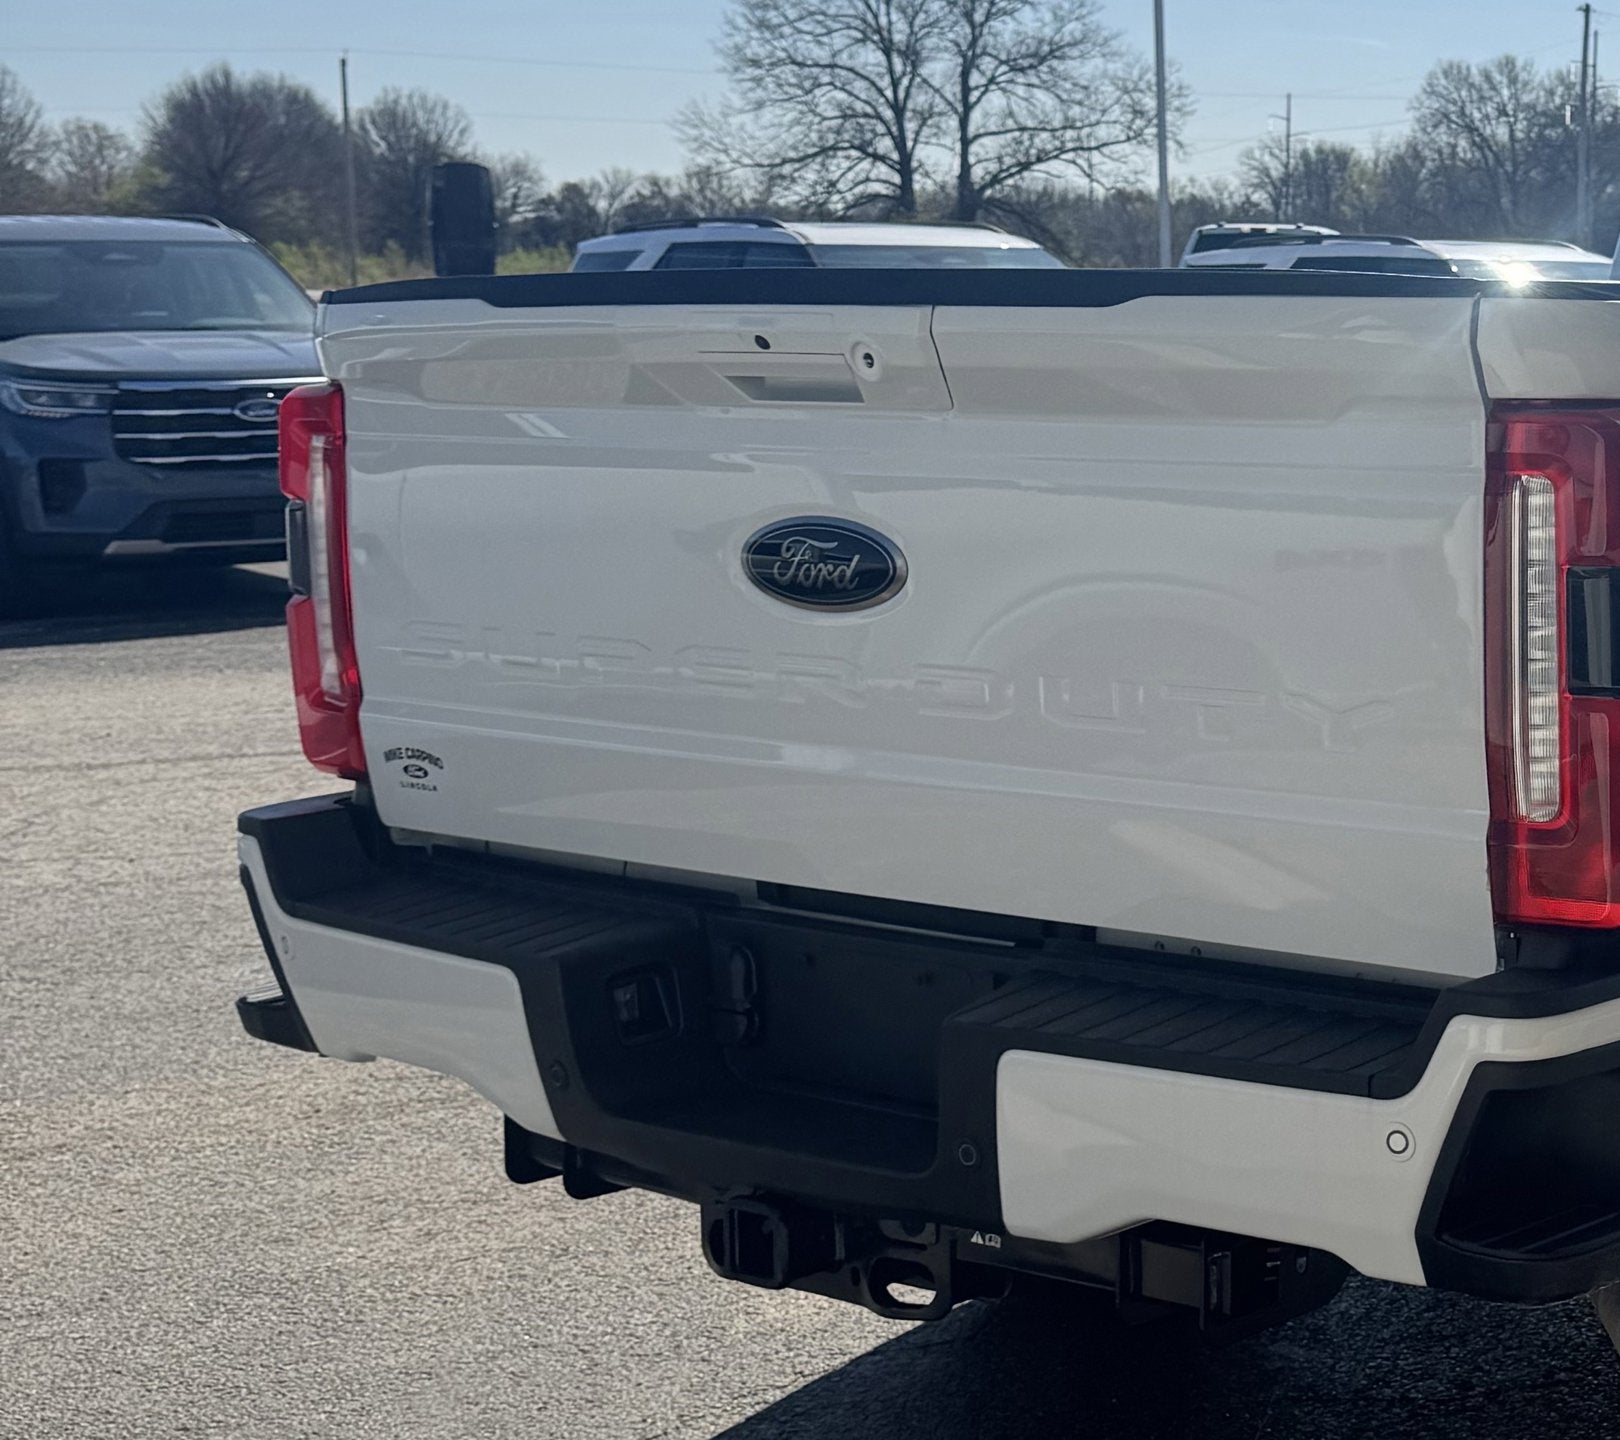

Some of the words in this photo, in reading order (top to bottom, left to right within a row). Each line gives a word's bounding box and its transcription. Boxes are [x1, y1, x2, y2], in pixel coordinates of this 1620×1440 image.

[774, 536, 862, 590] Ford
[398, 619, 868, 709] SUPER
[912, 662, 1402, 754] DUTY
